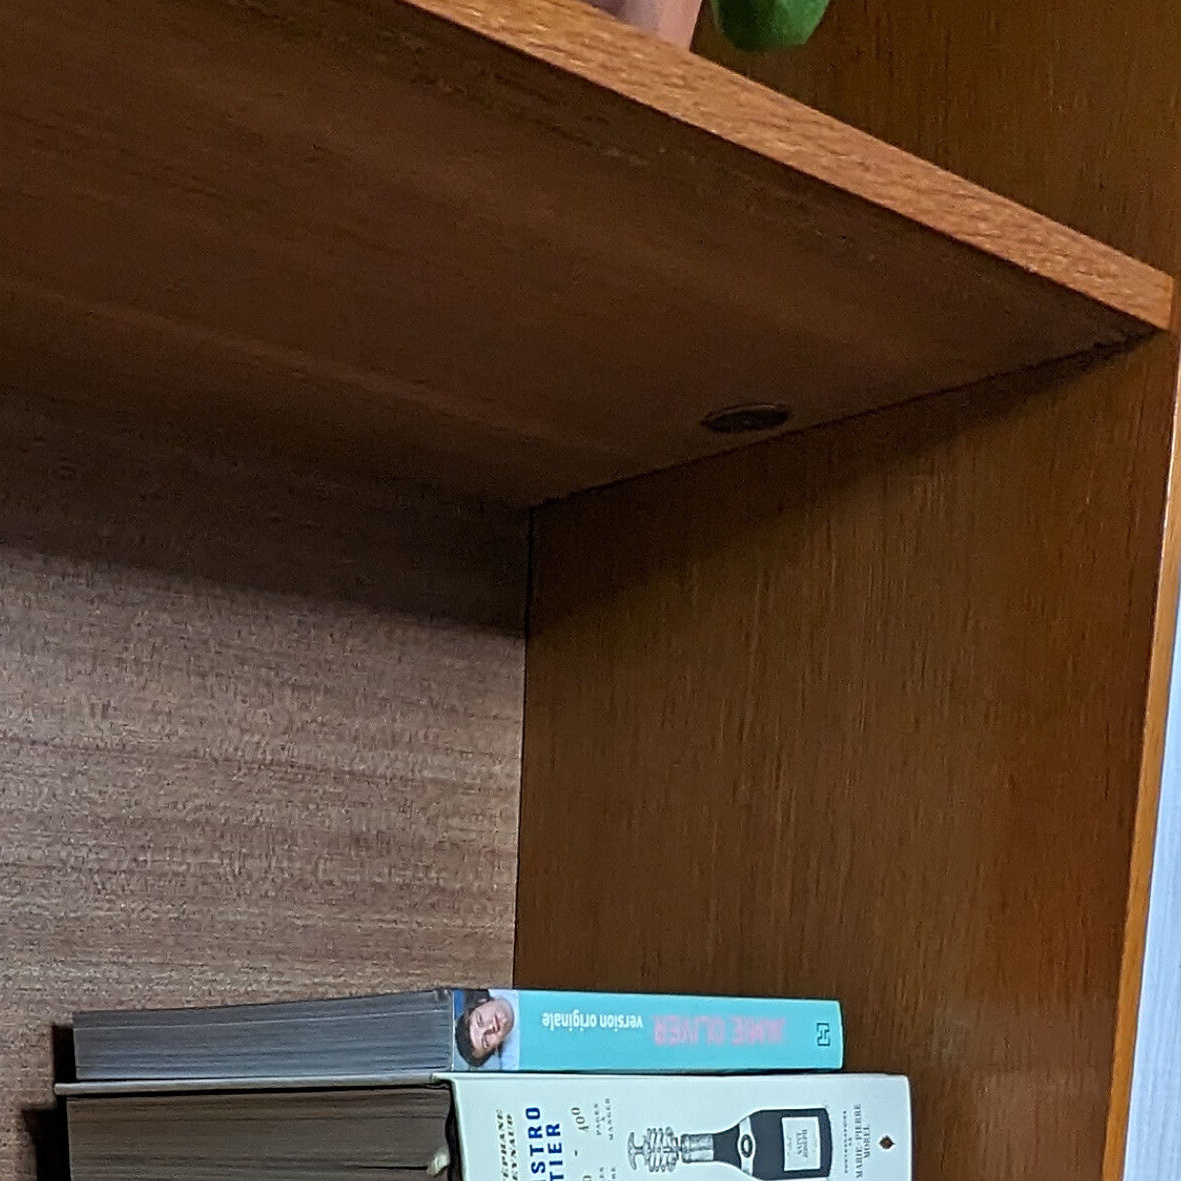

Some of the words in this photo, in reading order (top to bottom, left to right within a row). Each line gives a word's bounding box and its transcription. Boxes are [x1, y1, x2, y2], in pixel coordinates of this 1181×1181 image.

[541, 1010, 598, 1031] originale
[599, 1014, 644, 1030] version
[651, 1014, 727, 1046] OLIVER
[731, 1016, 787, 1047] JAMIE
